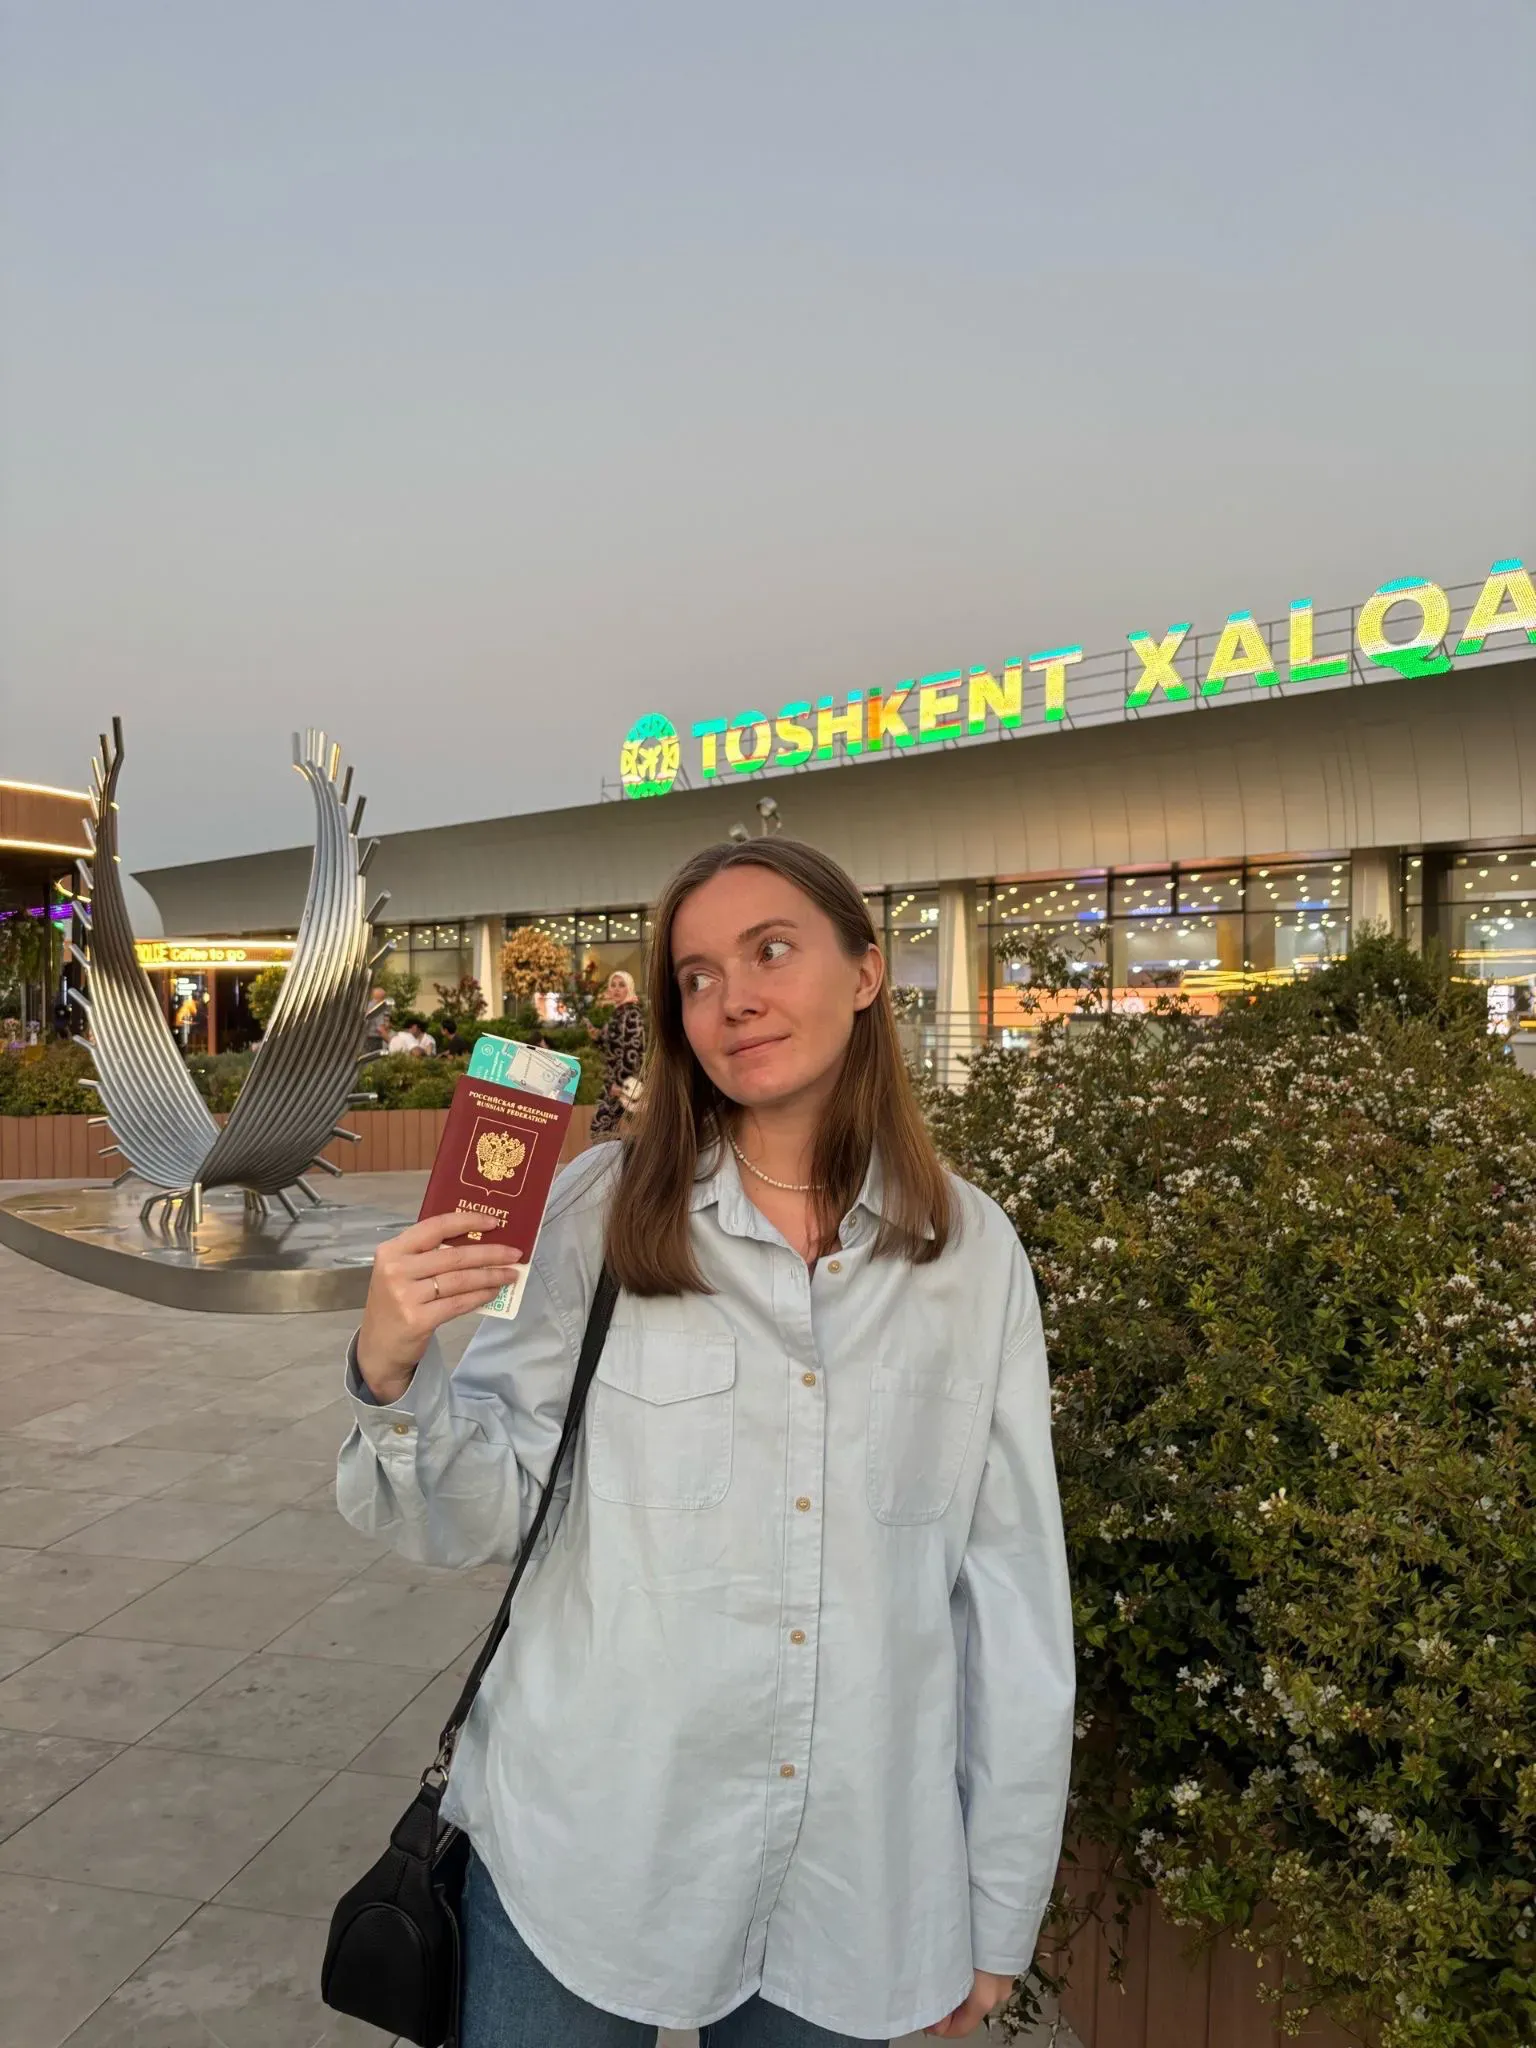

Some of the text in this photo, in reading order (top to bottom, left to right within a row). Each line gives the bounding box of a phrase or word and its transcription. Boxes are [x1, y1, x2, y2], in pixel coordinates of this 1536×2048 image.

[692, 557, 1536, 779] TOSHKENT XALQA
[170, 947, 208, 961] Coffee
[209, 948, 225, 961] to
[226, 949, 247, 962] go
[468, 1090, 559, 1121] РОССИЙСКАЯ ФЕДЕРАЦИЯ
[476, 1099, 548, 1125] RUSSIAN FEDERATION
[458, 1198, 510, 1219] ПАСПОРТ
